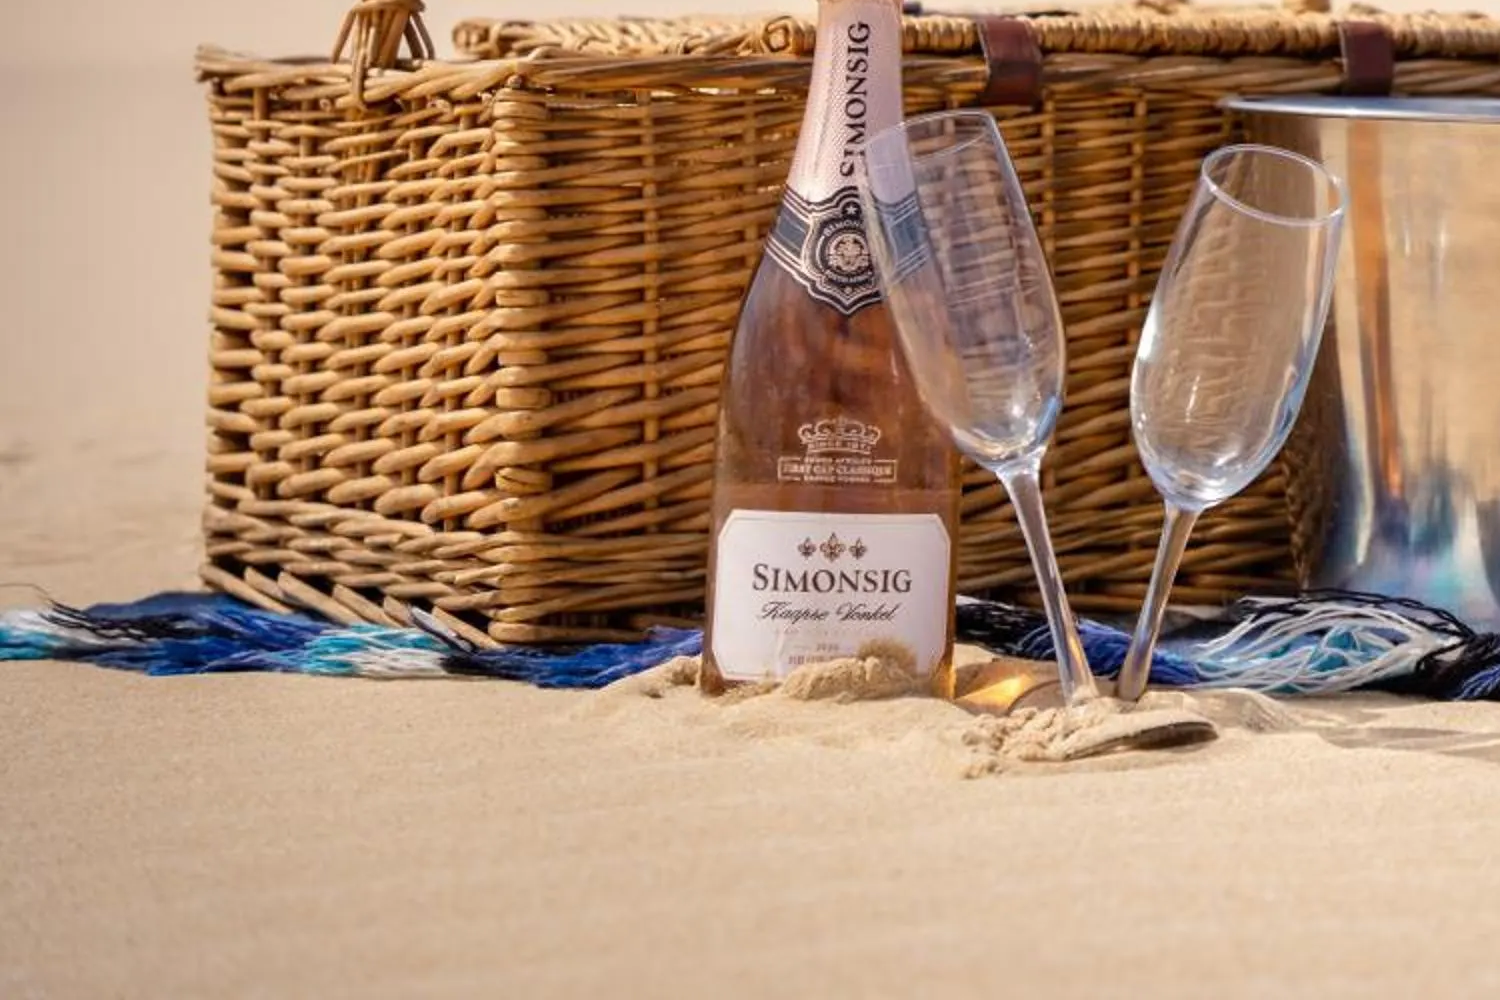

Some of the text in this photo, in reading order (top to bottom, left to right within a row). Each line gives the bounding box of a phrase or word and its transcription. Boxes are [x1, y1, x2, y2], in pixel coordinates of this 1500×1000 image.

[839, 21, 871, 178] SIMONSIG
[752, 563, 913, 593] SIMONSIG
[761, 601, 829, 624] Kaapse
